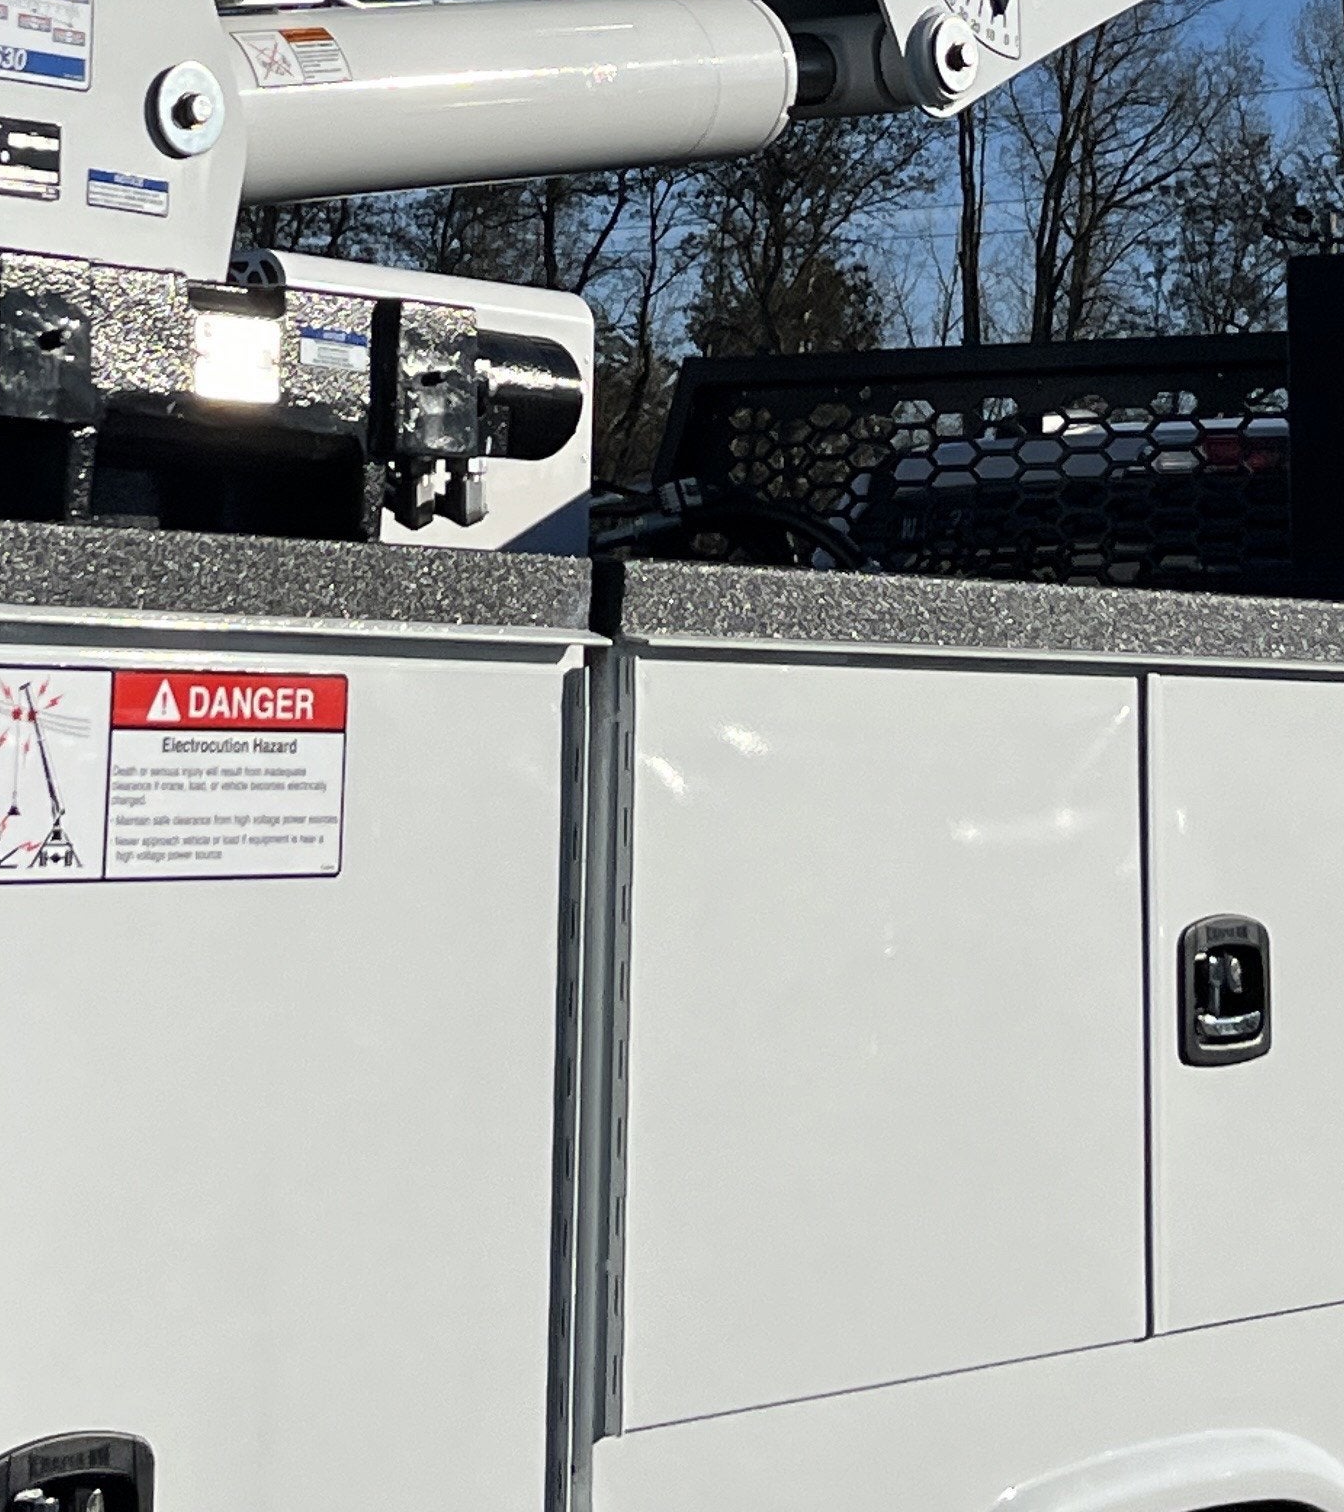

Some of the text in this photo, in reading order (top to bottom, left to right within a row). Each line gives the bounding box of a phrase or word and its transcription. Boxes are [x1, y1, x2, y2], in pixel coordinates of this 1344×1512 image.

[187, 685, 315, 721] DANGER
[161, 736, 298, 755] Electrocution Hazard
